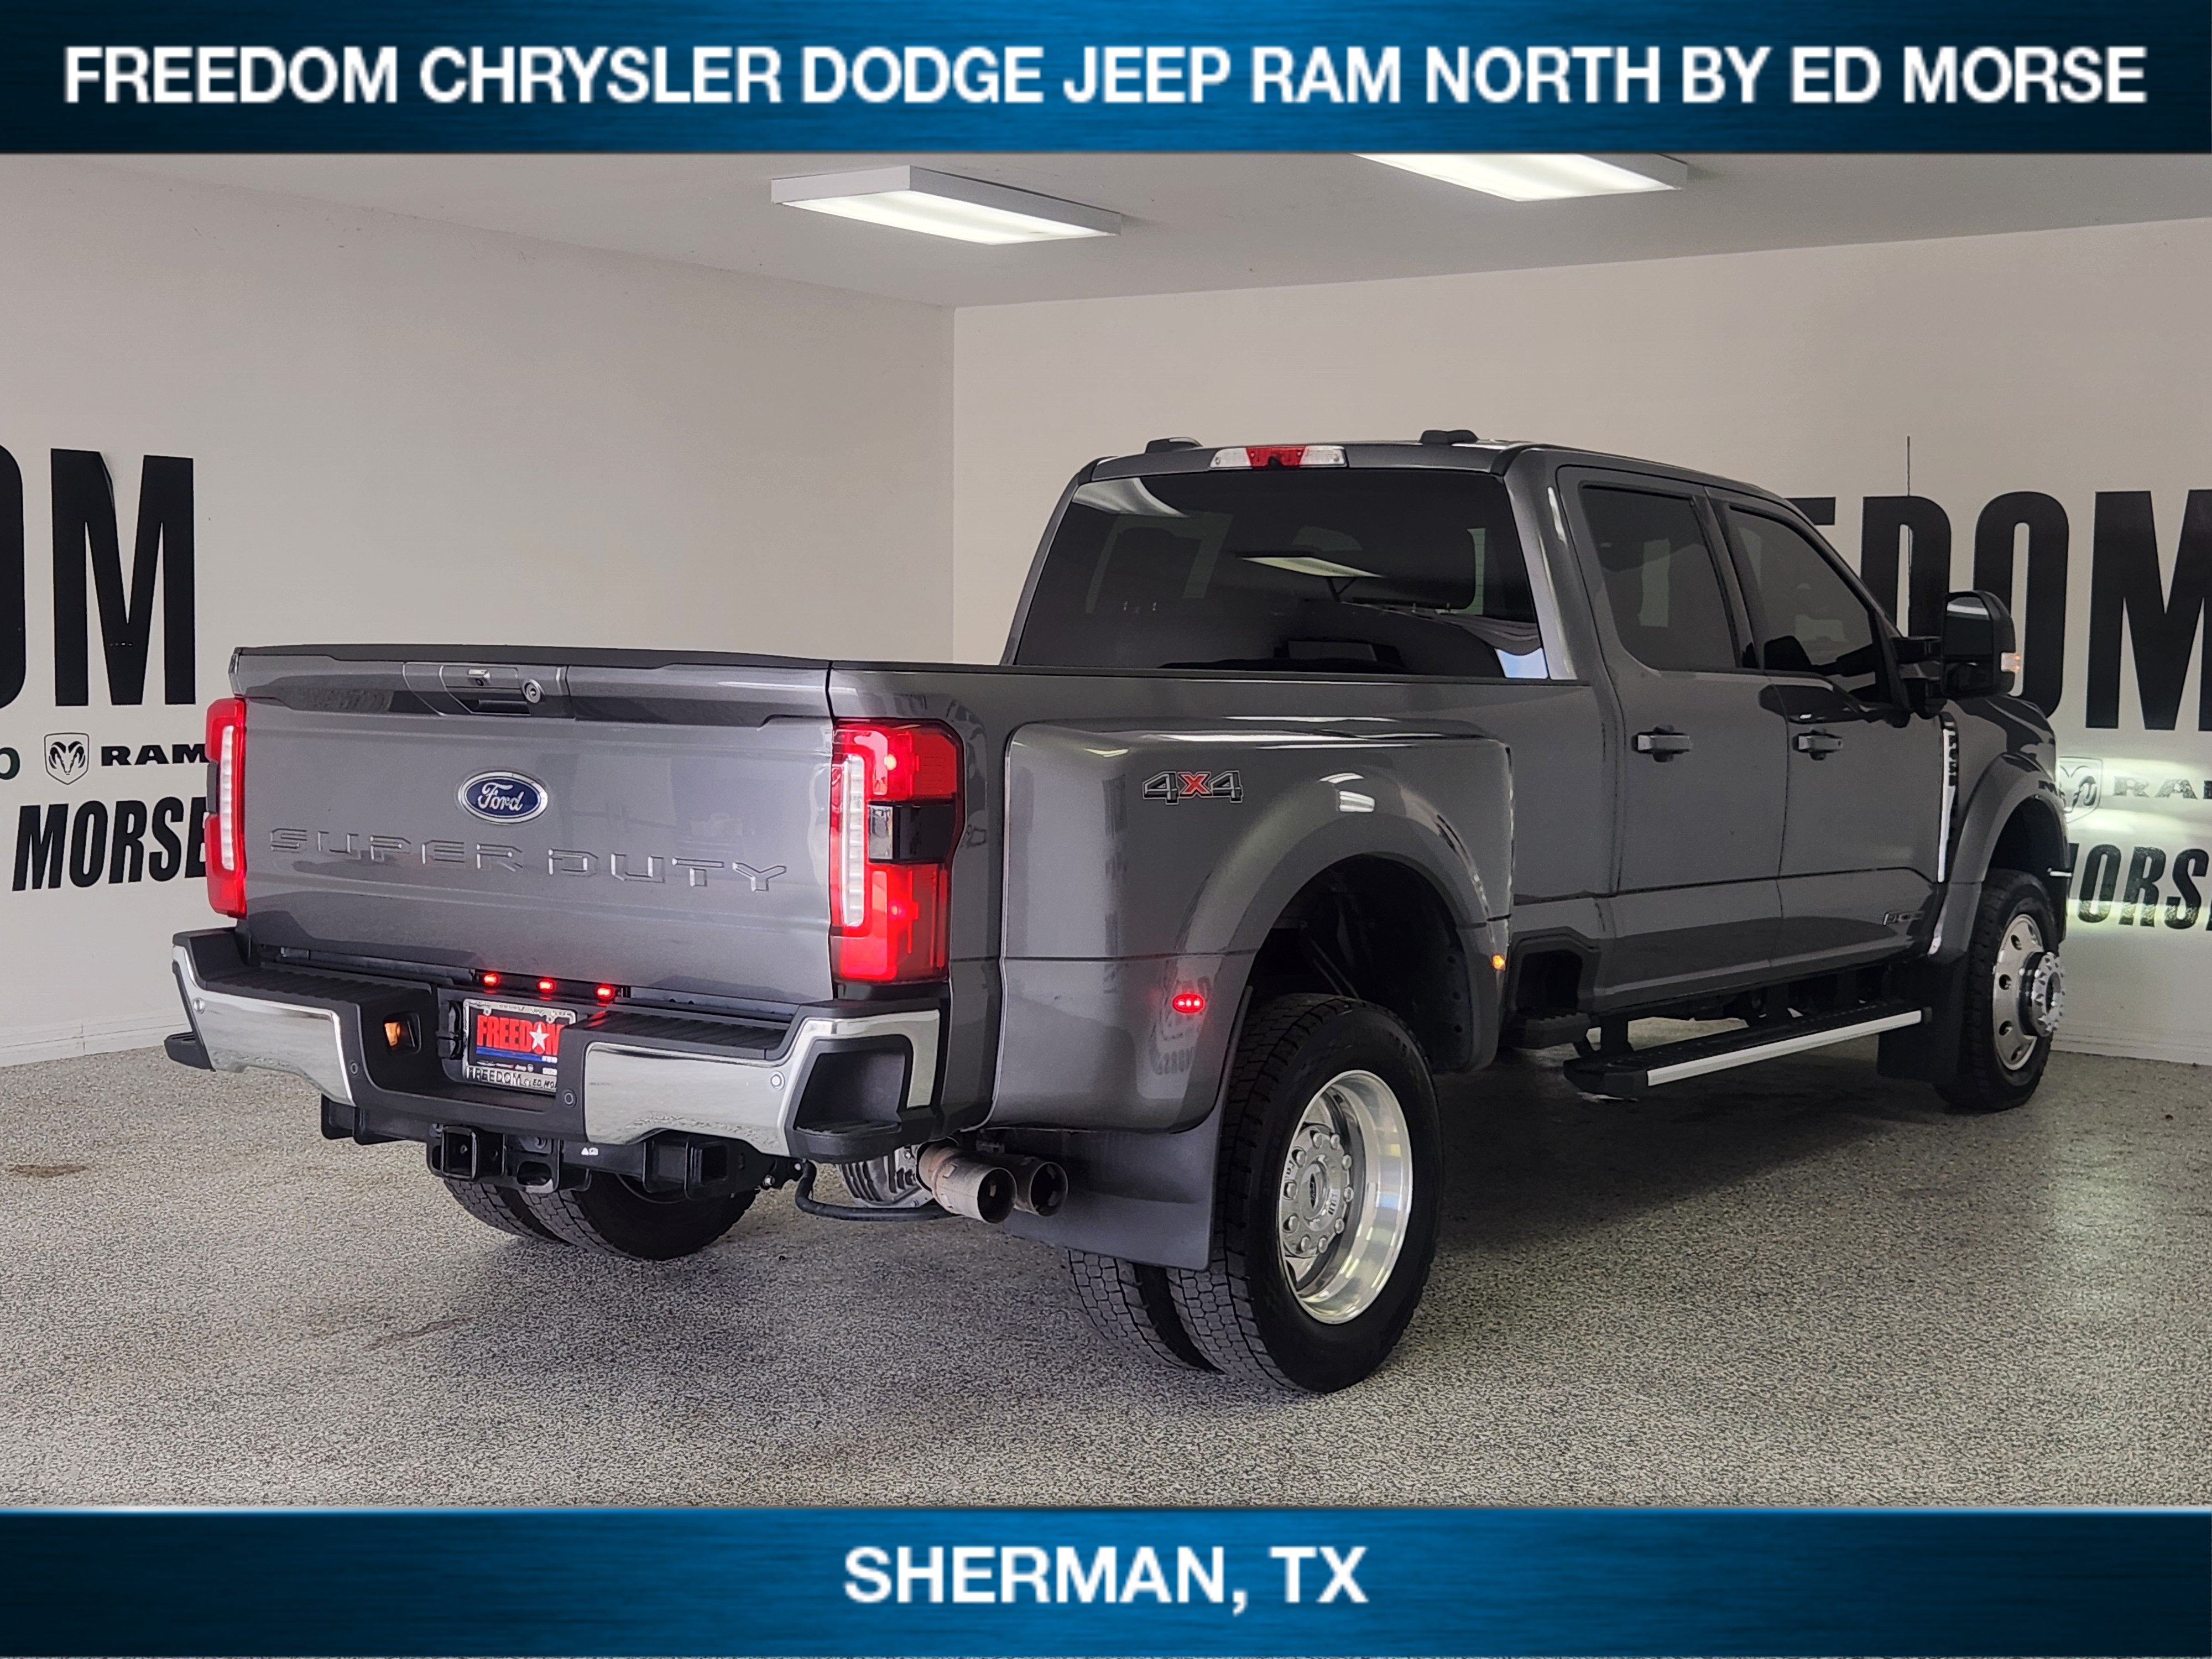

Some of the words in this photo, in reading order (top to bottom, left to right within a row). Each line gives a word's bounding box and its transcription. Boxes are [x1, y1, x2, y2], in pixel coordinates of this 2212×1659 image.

[1784, 491, 2212, 731] DOM
[478, 781, 523, 812] Ford
[2113, 775, 2212, 800] RA
[270, 828, 523, 873] SUPER
[548, 849, 788, 893] DUTY
[2067, 843, 2212, 931] ORS
